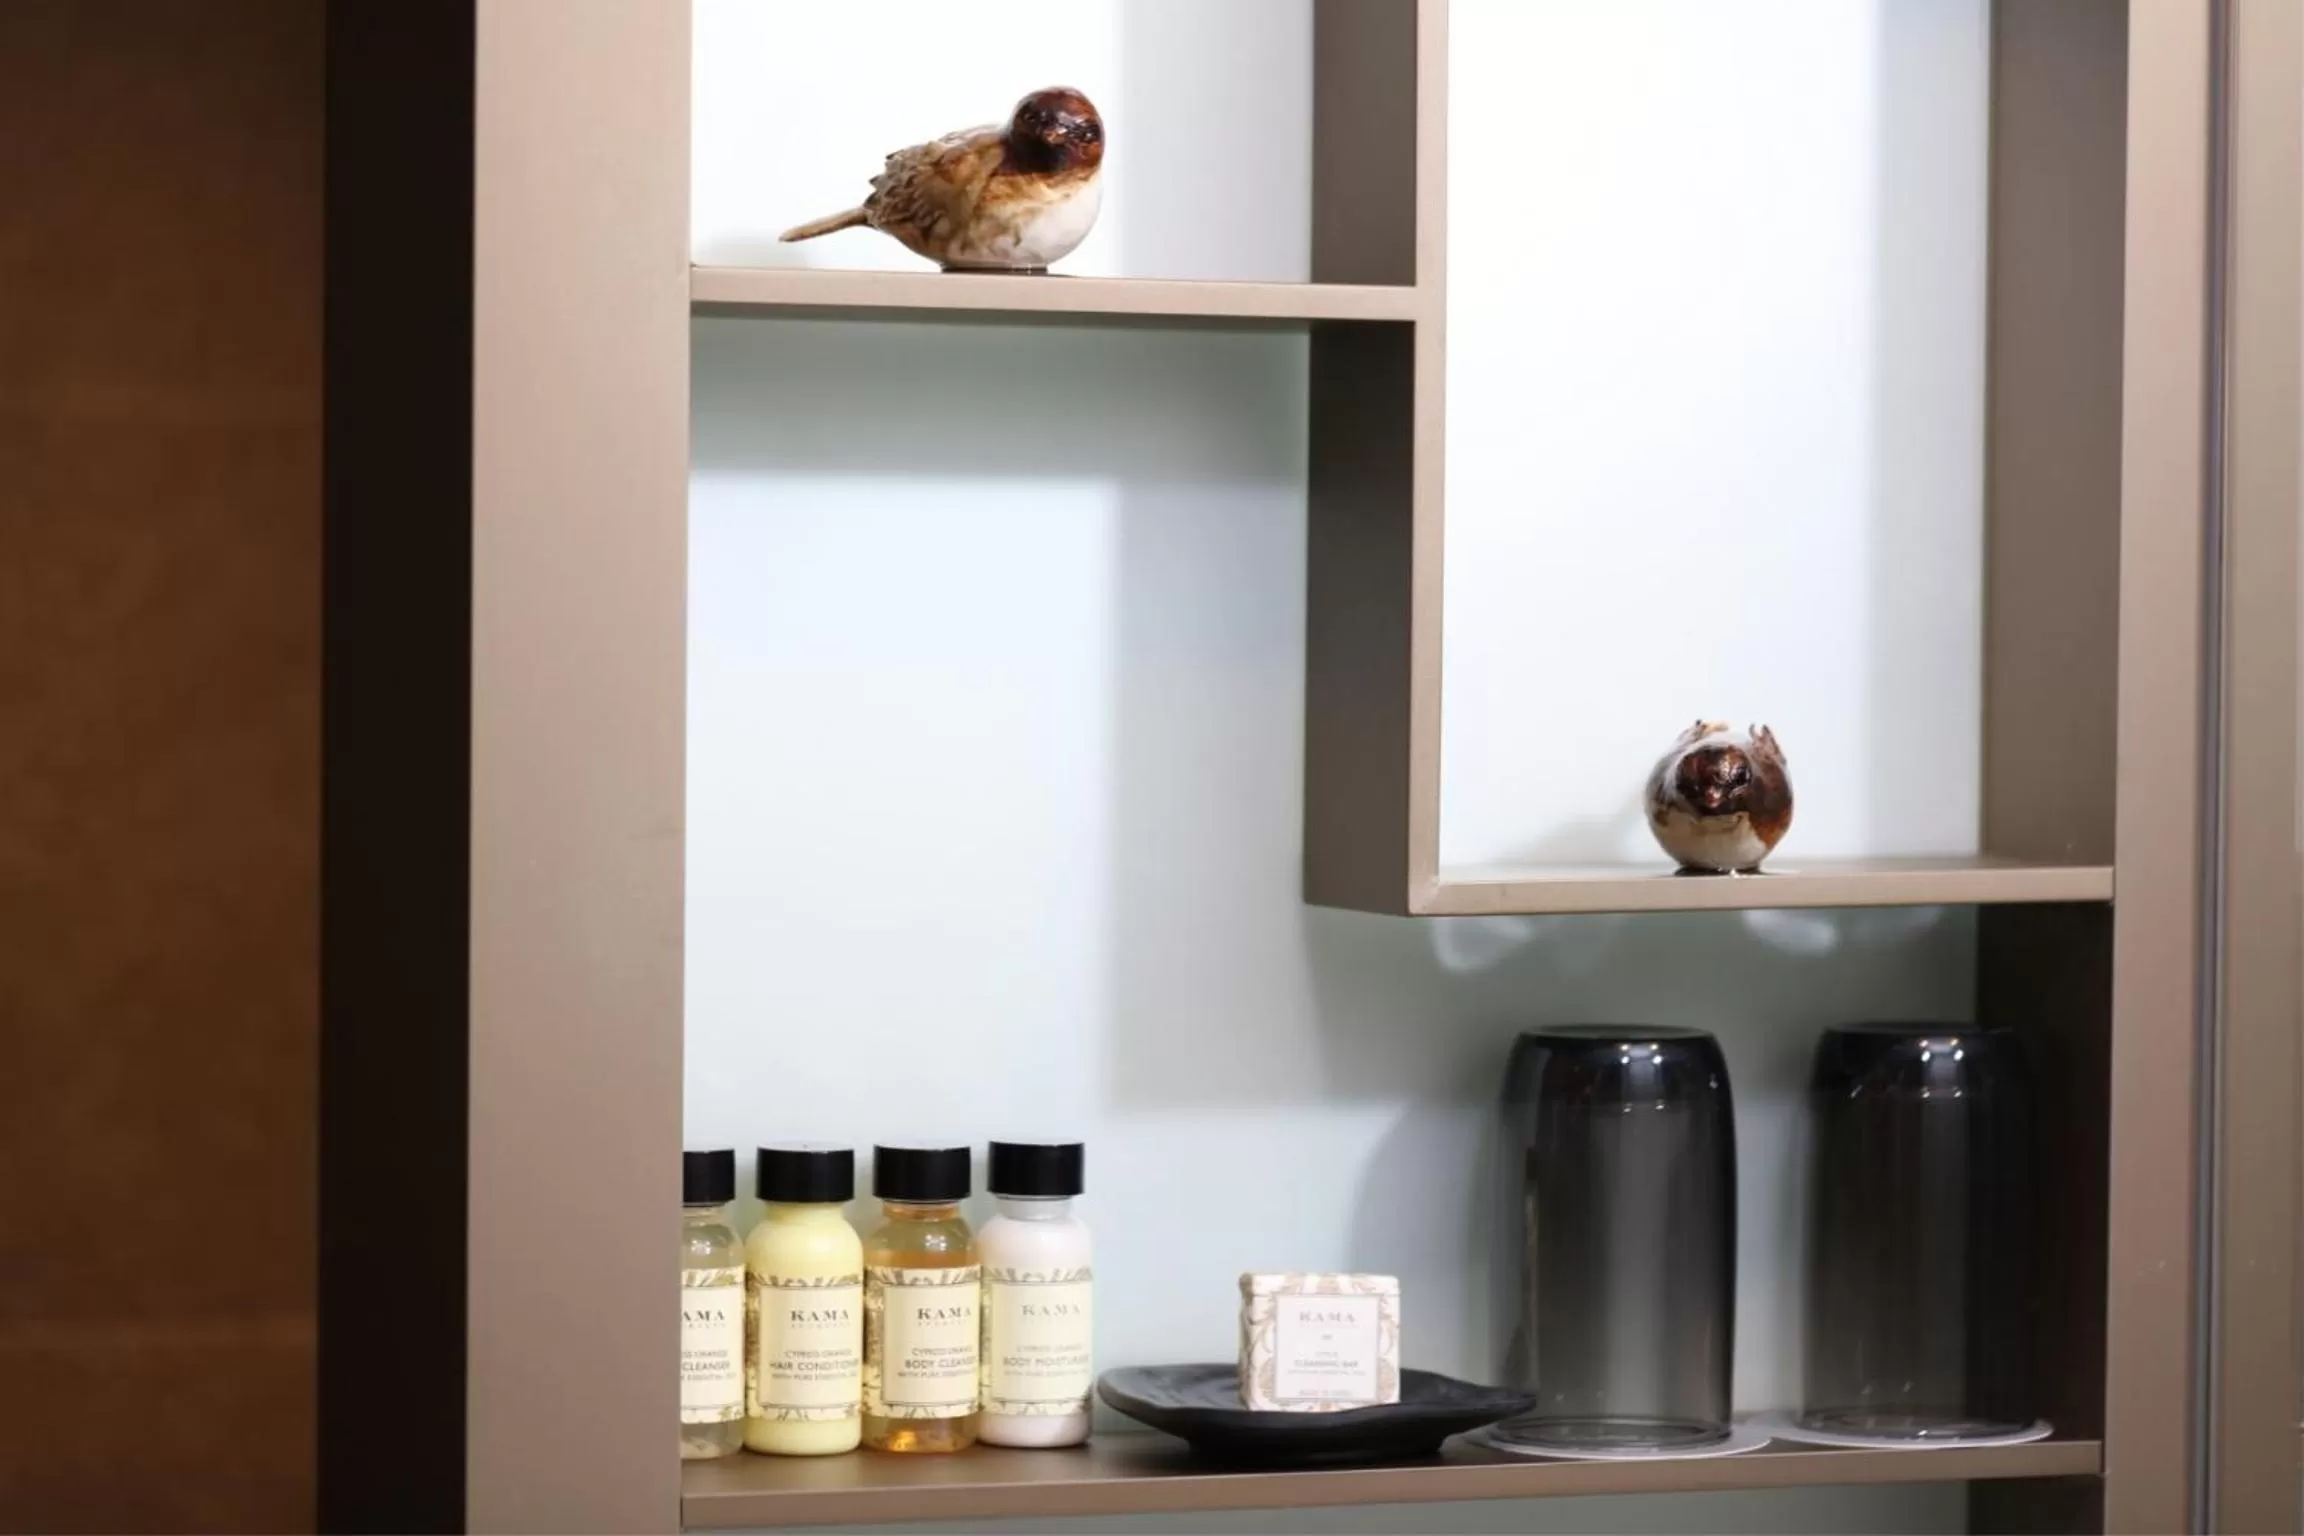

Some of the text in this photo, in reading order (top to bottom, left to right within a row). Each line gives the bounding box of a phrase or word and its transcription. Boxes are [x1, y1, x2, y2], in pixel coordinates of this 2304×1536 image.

[790, 1309, 850, 1321] KAMA
[917, 1307, 971, 1320] KAMA
[1021, 1303, 1081, 1316] KAMA
[1299, 1311, 1356, 1322] KAMA
[769, 1361, 794, 1370] HAIR
[904, 1358, 934, 1369] BODY
[1003, 1355, 1031, 1367] BODY
